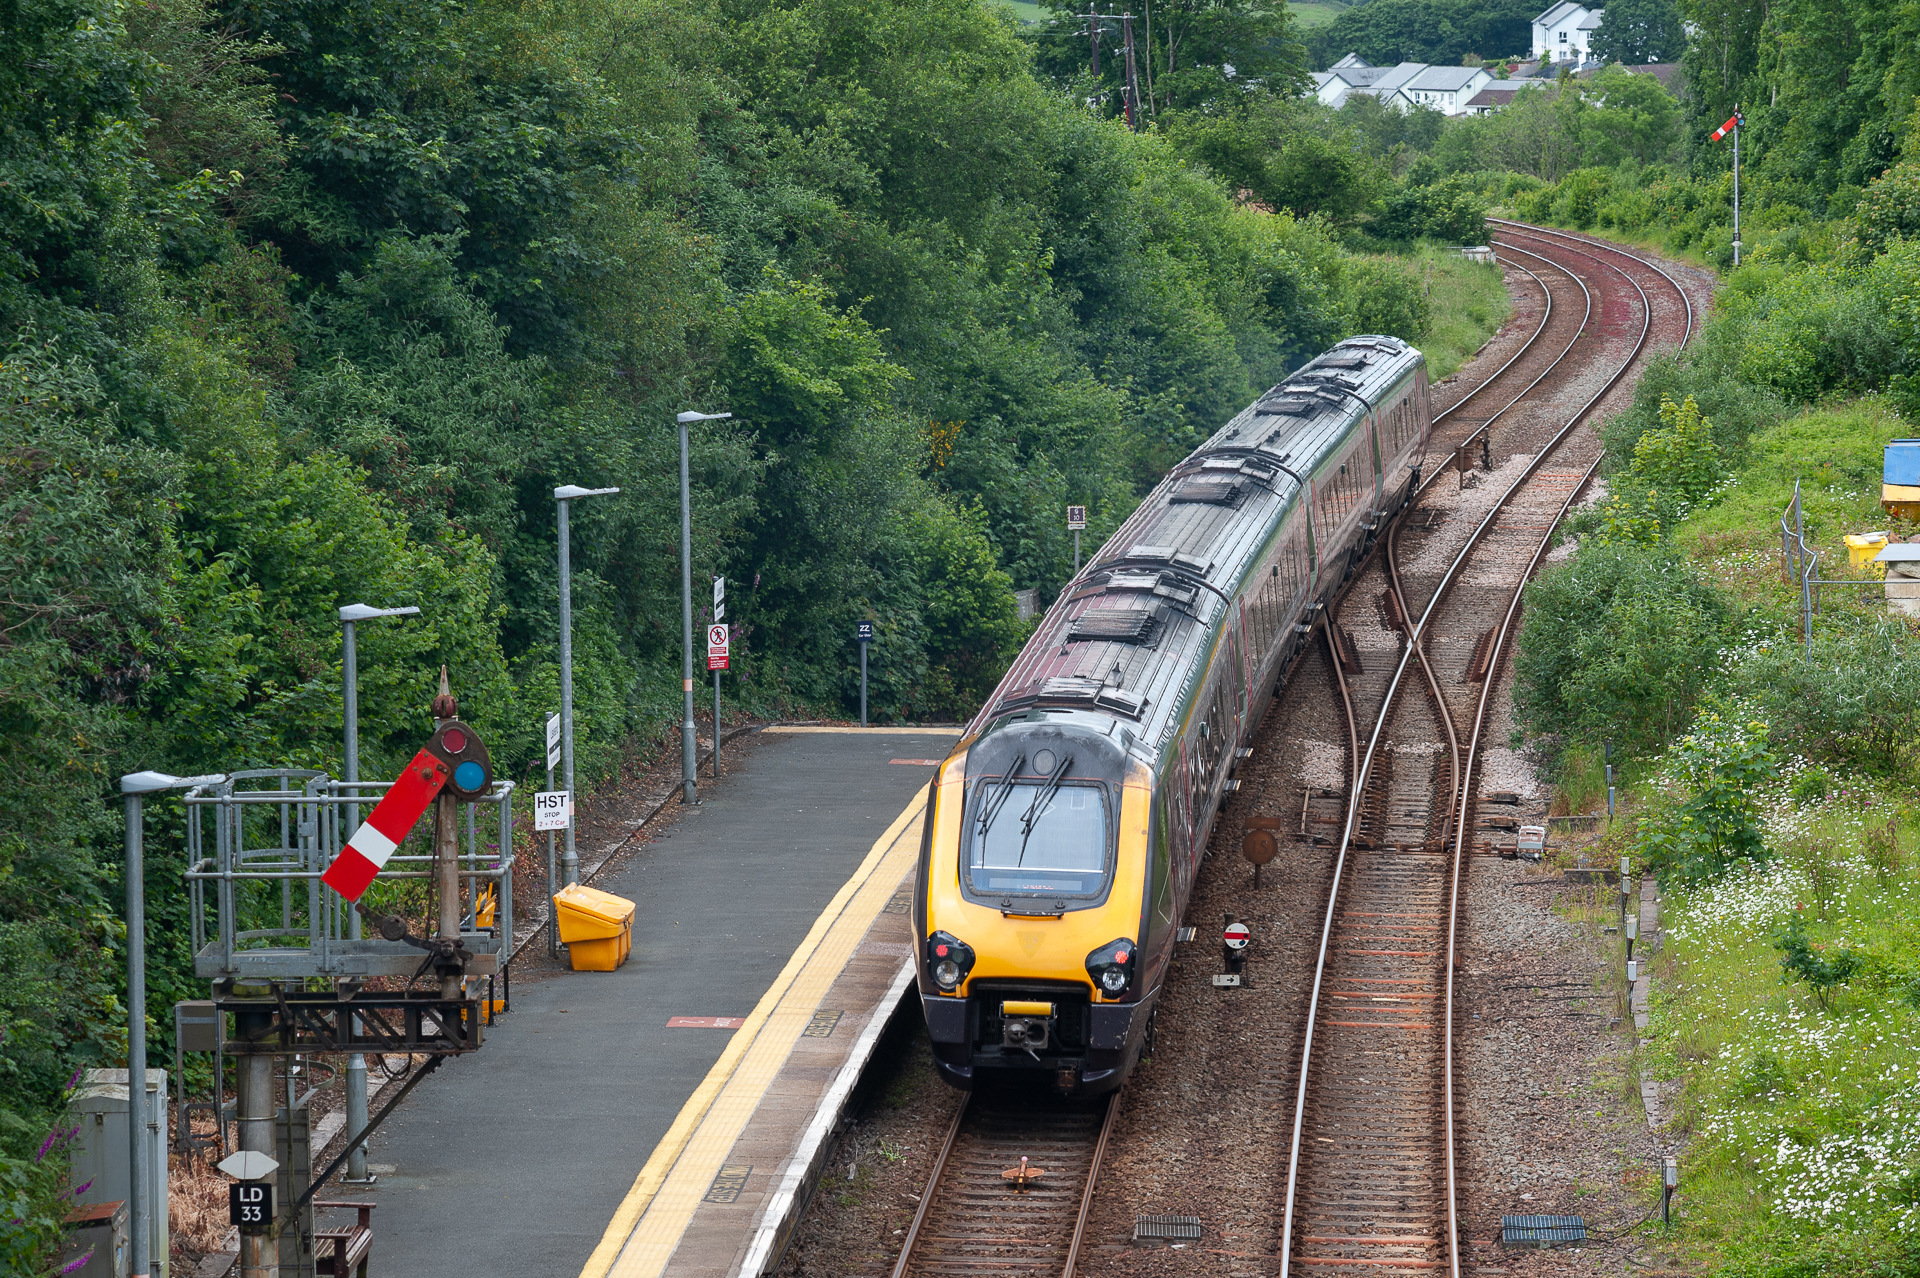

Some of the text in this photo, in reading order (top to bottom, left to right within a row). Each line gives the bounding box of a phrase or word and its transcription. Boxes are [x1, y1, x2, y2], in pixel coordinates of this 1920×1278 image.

[537, 795, 567, 808] HST
[239, 1187, 263, 1202] LD
[241, 1205, 262, 1222] 33
